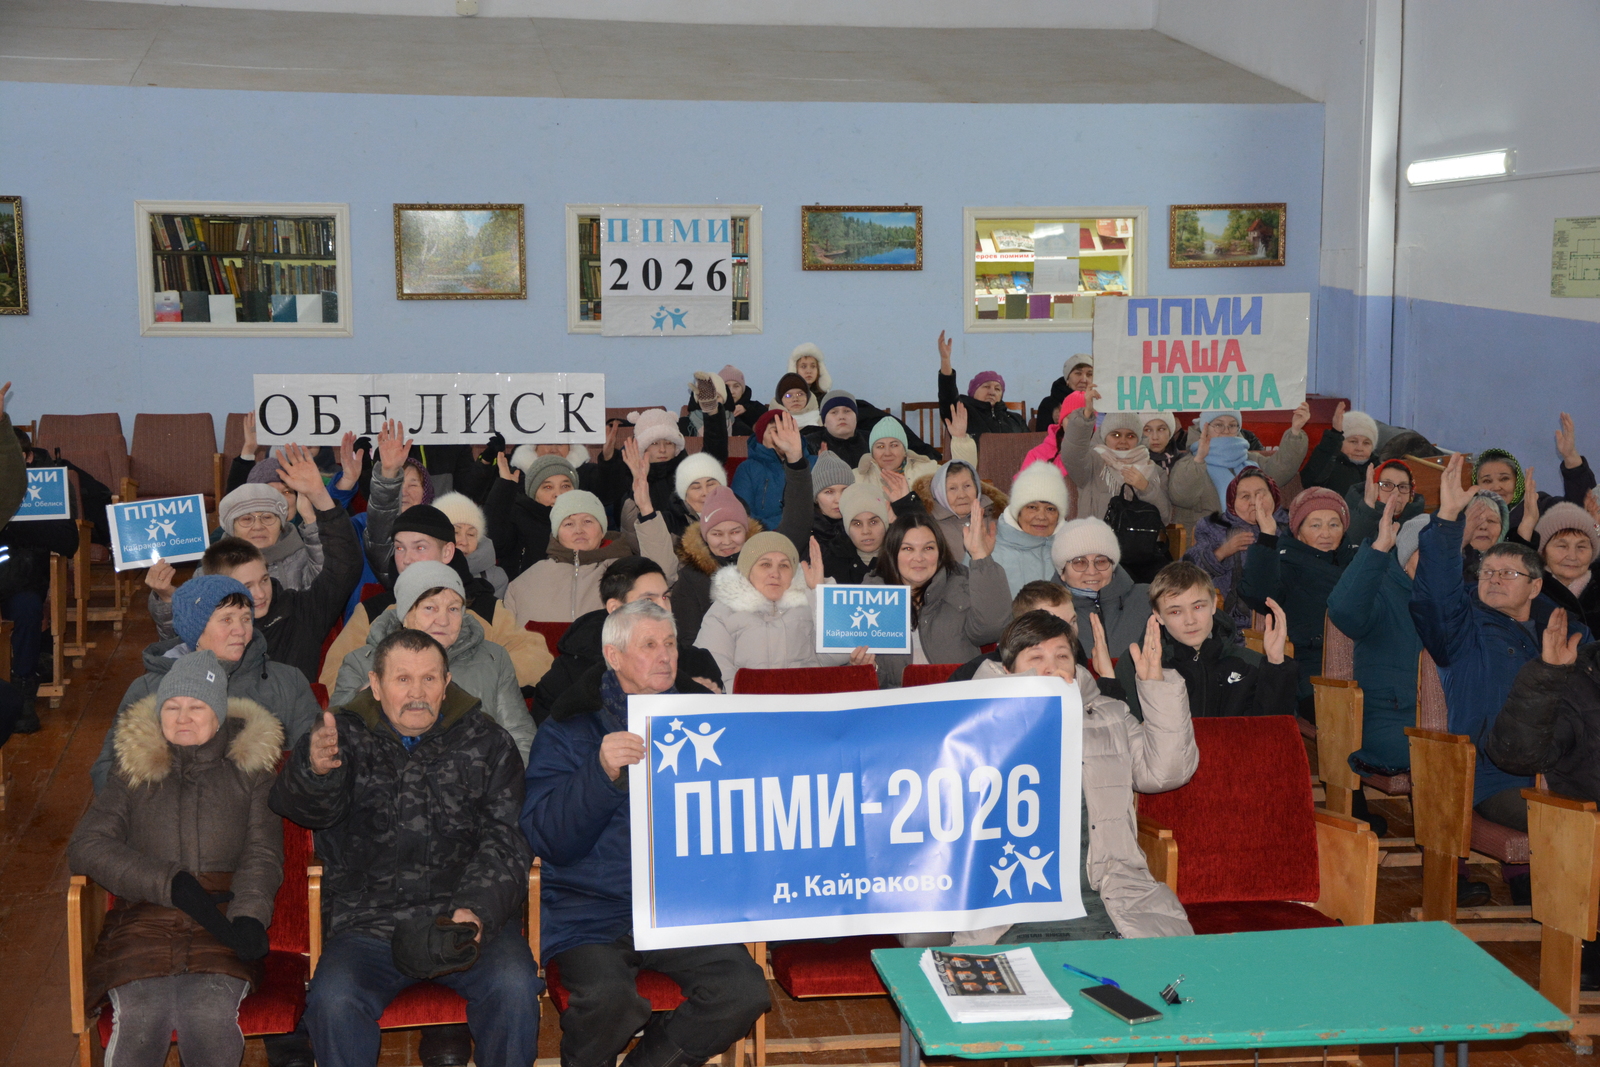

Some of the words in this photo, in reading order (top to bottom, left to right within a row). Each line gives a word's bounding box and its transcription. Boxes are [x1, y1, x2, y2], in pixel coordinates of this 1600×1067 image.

[606, 218, 730, 243] ППМИ
[609, 257, 728, 292] 2026
[1127, 296, 1263, 336] ППМИ
[1142, 338, 1247, 374] НАША
[1117, 373, 1283, 411] НАДЕЖДА
[258, 391, 598, 436] ОБЕЛИСК
[28, 471, 58, 483] МИ
[124, 499, 194, 521] ППМИ
[123, 540, 167, 553] Кайраково
[169, 536, 203, 547] Обелиск
[833, 590, 899, 605] ППМИ
[826, 629, 868, 638] Кайраково
[871, 630, 904, 638] Обелиск
[674, 763, 1041, 857] ППМИ-2026
[773, 882, 799, 904] д.
[804, 872, 953, 901] Кайраково
